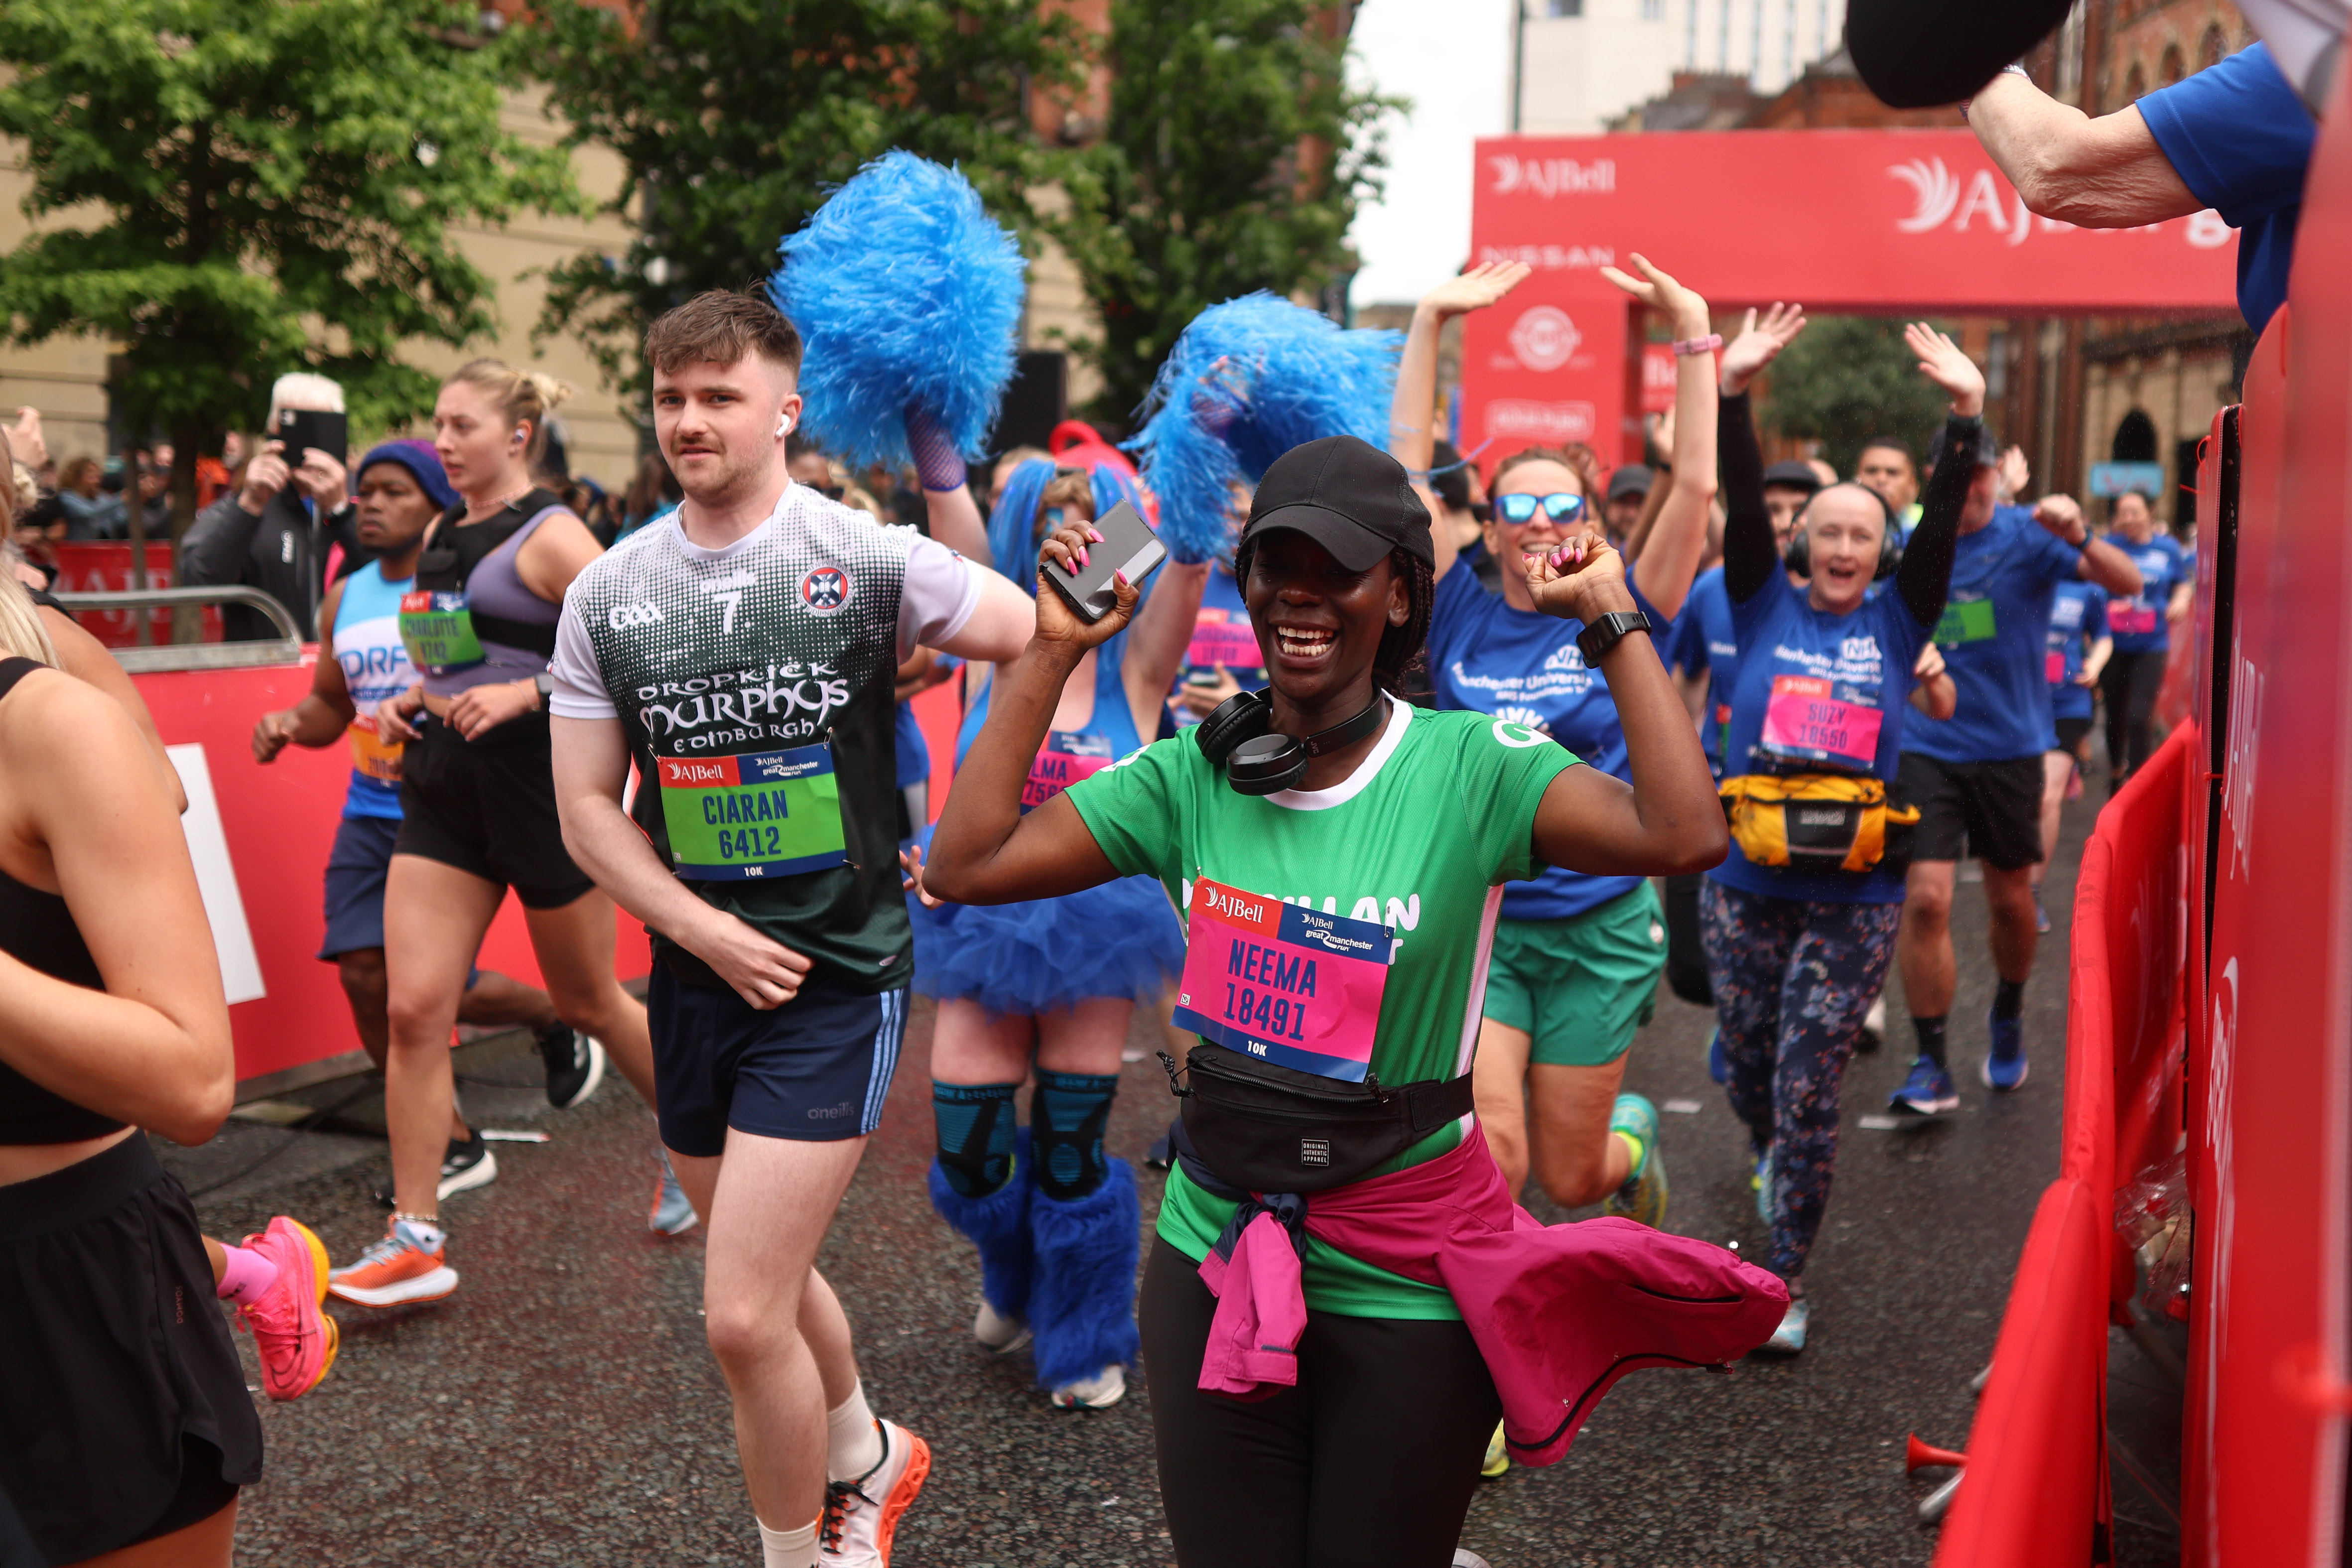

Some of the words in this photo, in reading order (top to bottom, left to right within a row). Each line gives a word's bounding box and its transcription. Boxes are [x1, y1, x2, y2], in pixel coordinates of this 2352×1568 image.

[714, 591, 742, 634] 7
[1808, 702, 1847, 726] SUZY
[1799, 723, 1847, 750] 18550
[680, 764, 724, 783] AJBell
[763, 767, 778, 776] great
[783, 761, 818, 772] manchester
[1030, 756, 1067, 782] LMA
[702, 789, 788, 825] CIARAN
[718, 826, 782, 859] 6412
[744, 866, 764, 877] 10K
[1216, 894, 1264, 924] AJBell
[1309, 917, 1333, 929] AJBell
[1306, 930, 1324, 940] great
[1330, 936, 1373, 950] manchester
[1228, 939, 1317, 998] NEEMA
[1224, 983, 1307, 1041] 18491
[1247, 1041, 1268, 1057] 10K
